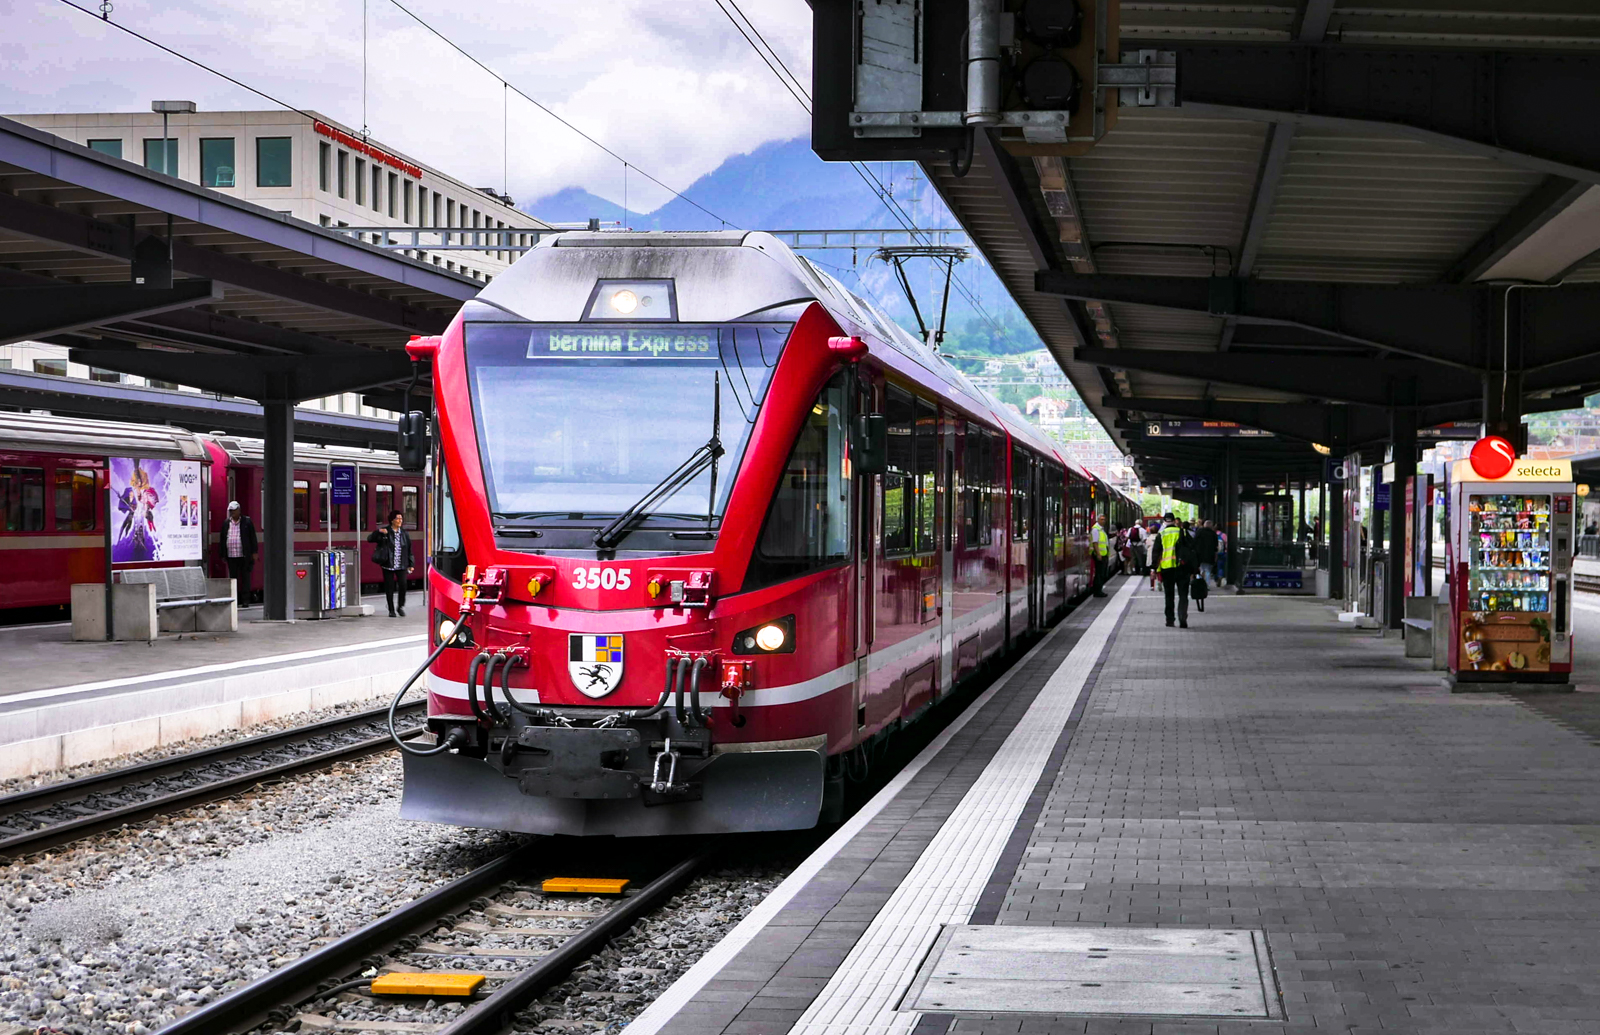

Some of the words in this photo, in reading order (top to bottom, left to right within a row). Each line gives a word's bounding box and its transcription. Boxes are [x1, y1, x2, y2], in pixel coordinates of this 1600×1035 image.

[549, 333, 622, 352] Bernina
[1148, 425, 1160, 435] 10
[1517, 466, 1561, 476] selecta
[1182, 479, 1194, 489] 10
[1199, 479, 1208, 489] C
[572, 567, 631, 590] 3505
